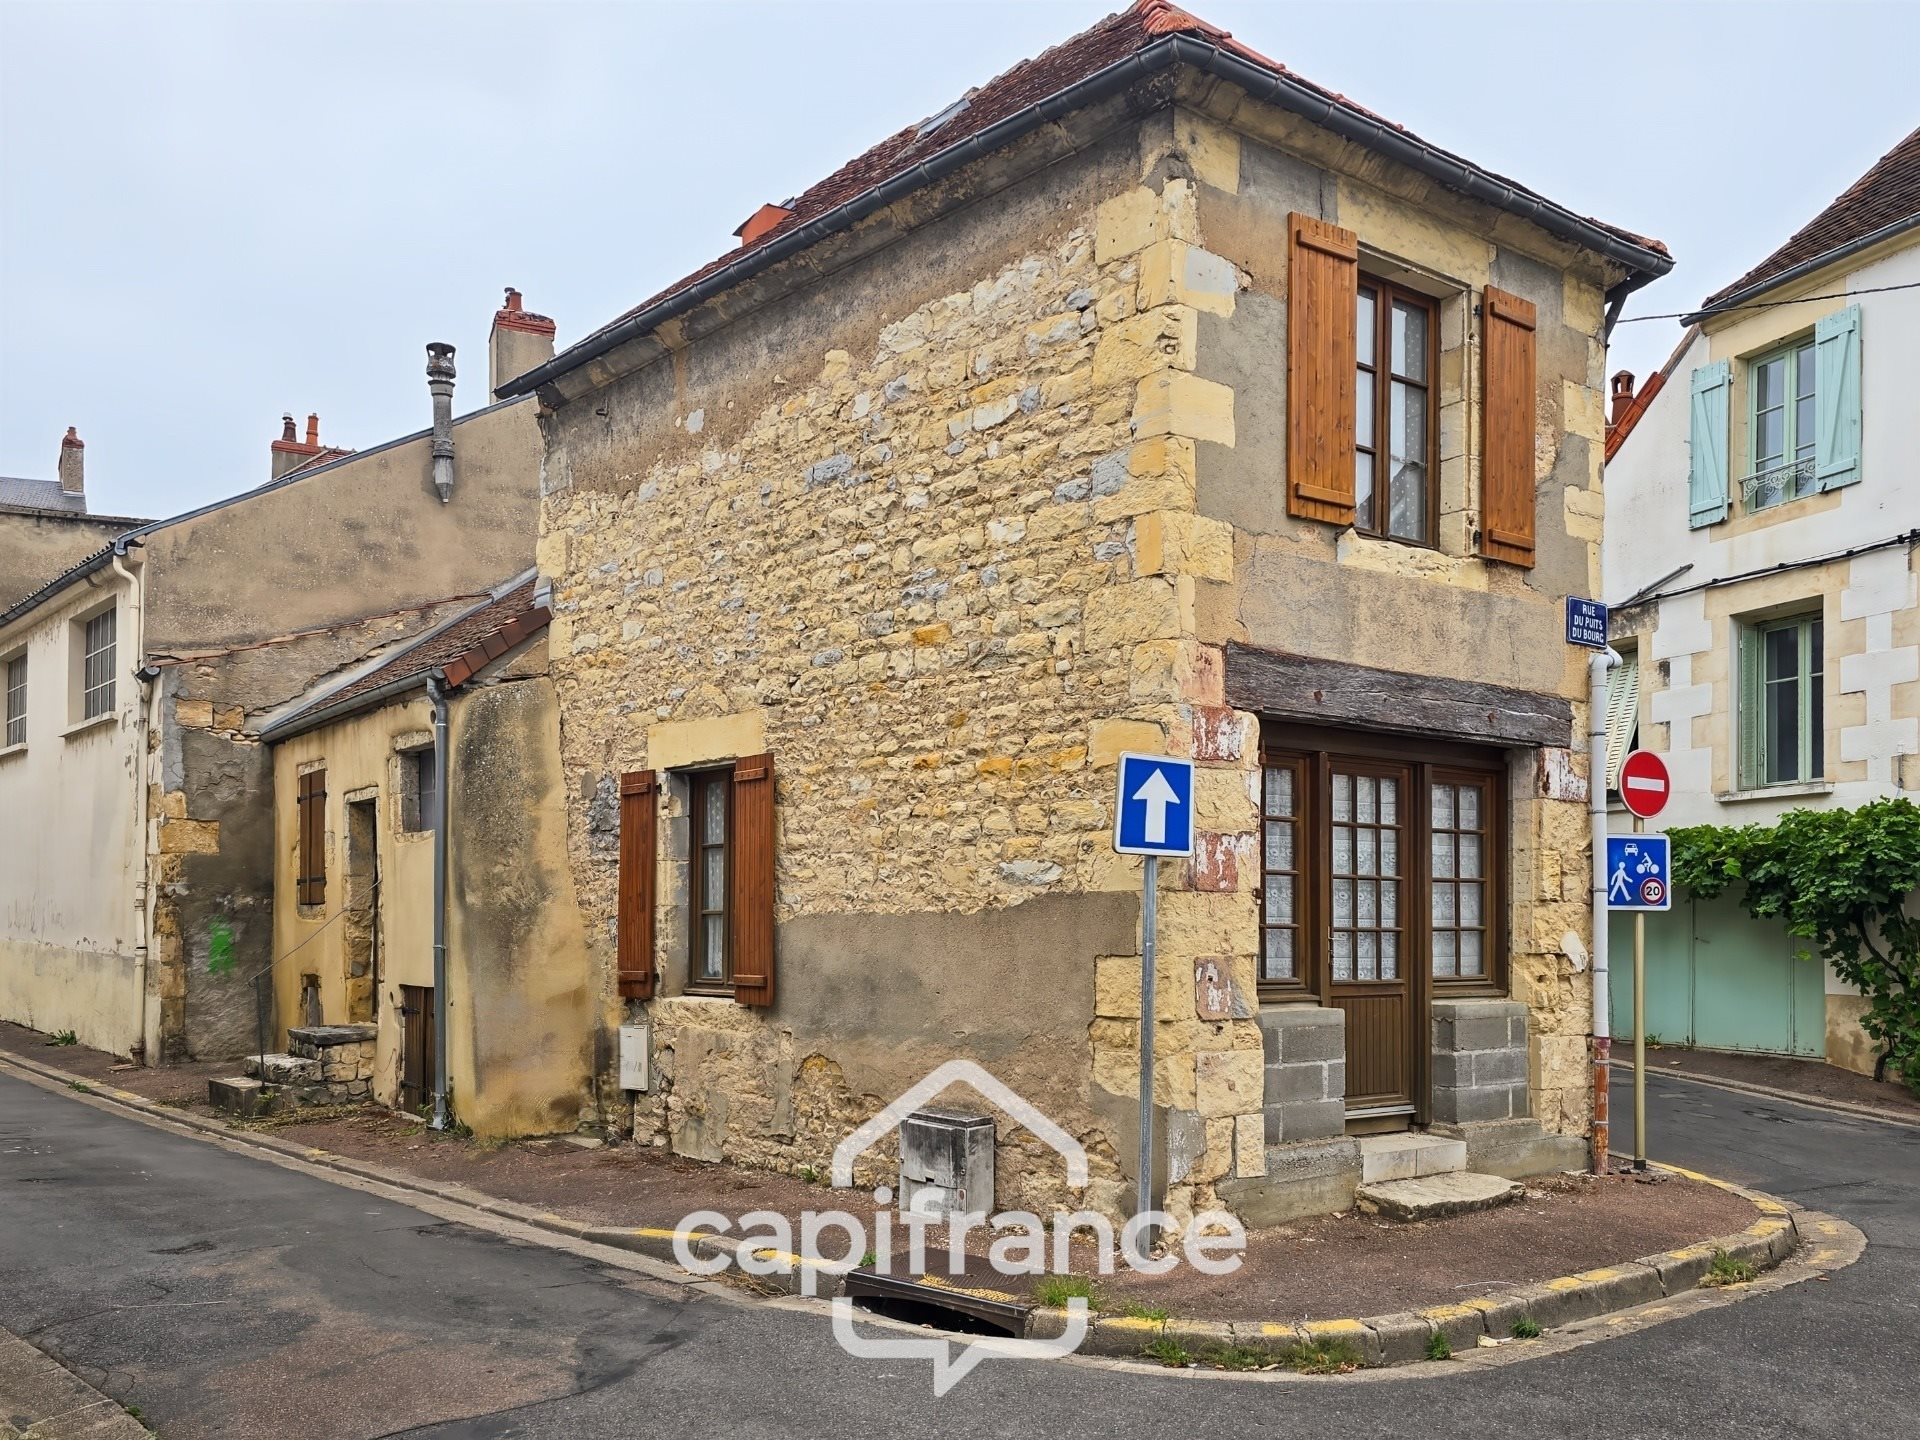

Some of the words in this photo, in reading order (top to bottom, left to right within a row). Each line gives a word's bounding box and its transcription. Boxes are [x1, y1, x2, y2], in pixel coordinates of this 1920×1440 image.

[1582, 604, 1595, 616] RUE
[1574, 615, 1583, 625] DU
[1585, 617, 1603, 630] PUITS
[1572, 627, 1582, 638] DU
[1583, 629, 1604, 643] BOURG
[1645, 886, 1660, 896] 20
